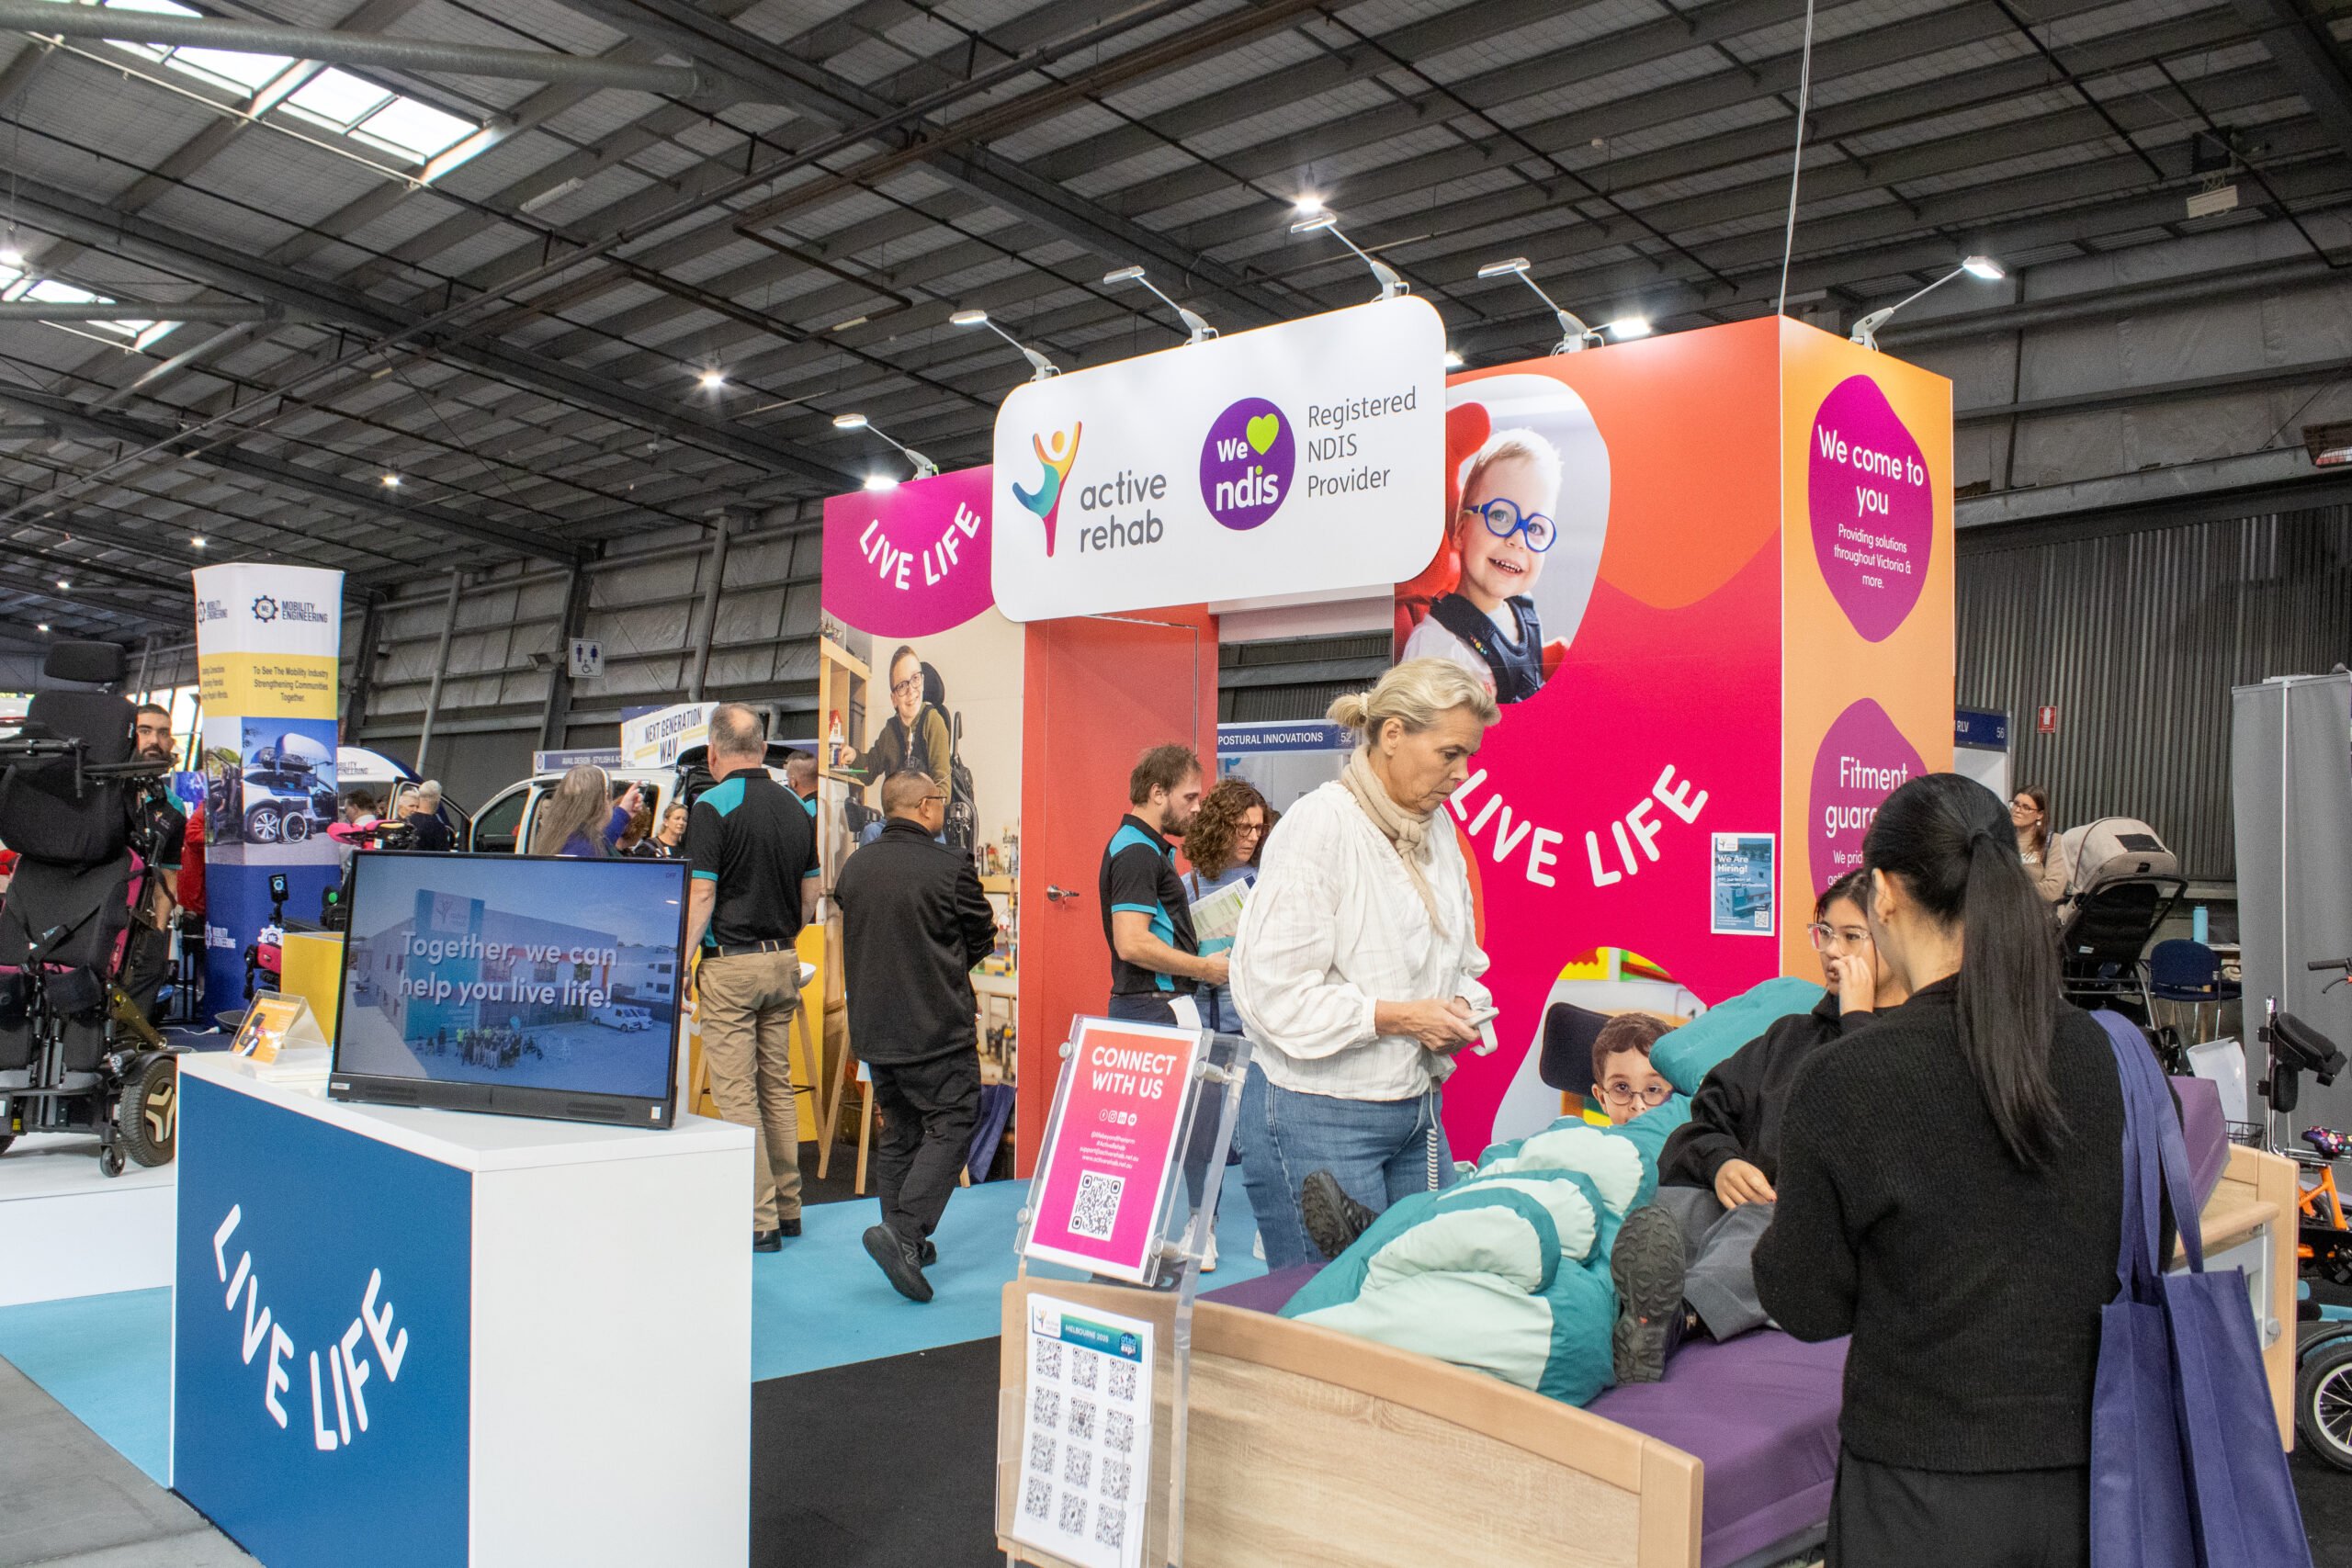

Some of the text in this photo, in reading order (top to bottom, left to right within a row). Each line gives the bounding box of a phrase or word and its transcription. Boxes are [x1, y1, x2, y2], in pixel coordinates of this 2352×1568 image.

[1307, 385, 1417, 431] Registered
[1216, 437, 1249, 463] We
[1307, 433, 1358, 463] NDIS
[1817, 423, 1924, 487] We come to
[1080, 469, 1167, 511] active
[1216, 465, 1279, 512] ndis
[1307, 466, 1391, 498] Provider
[1856, 485, 1889, 517] you
[1080, 508, 1164, 553] rehab
[1838, 524, 1907, 554] Providing solutions
[859, 502, 981, 591] LIVE LIFE
[1834, 543, 1912, 574] throughout Victoria &
[1861, 574, 1884, 590] more.
[281, 600, 316, 612] MOBILITY
[281, 610, 329, 624] ENGINEERING
[253, 666, 329, 679] To See The Mobility Industry
[254, 678, 329, 691] Strengthening Communities
[645, 722, 661, 744] NEXT
[661, 706, 703, 738] GENERATION
[1217, 731, 1351, 746] POSTURAL INNOVATIONS 52
[1956, 720, 1970, 733] RLV
[660, 737, 678, 764] WAV
[1839, 756, 1908, 790] Fitment
[1450, 764, 1708, 887] LIVE LIFE
[1825, 806, 1878, 839] guar
[1717, 854, 1749, 863] We Are
[1717, 863, 1748, 874] Hiring!
[1833, 850, 1863, 868] We prid
[401, 931, 617, 966] Together, we can
[398, 971, 613, 1009] help you live life!
[1091, 1045, 1177, 1076] CONNECT
[1091, 1070, 1164, 1100] WITH US
[213, 1203, 409, 1451] LIVE LIFE
[1065, 1324, 1096, 1339] MELBOURNE
